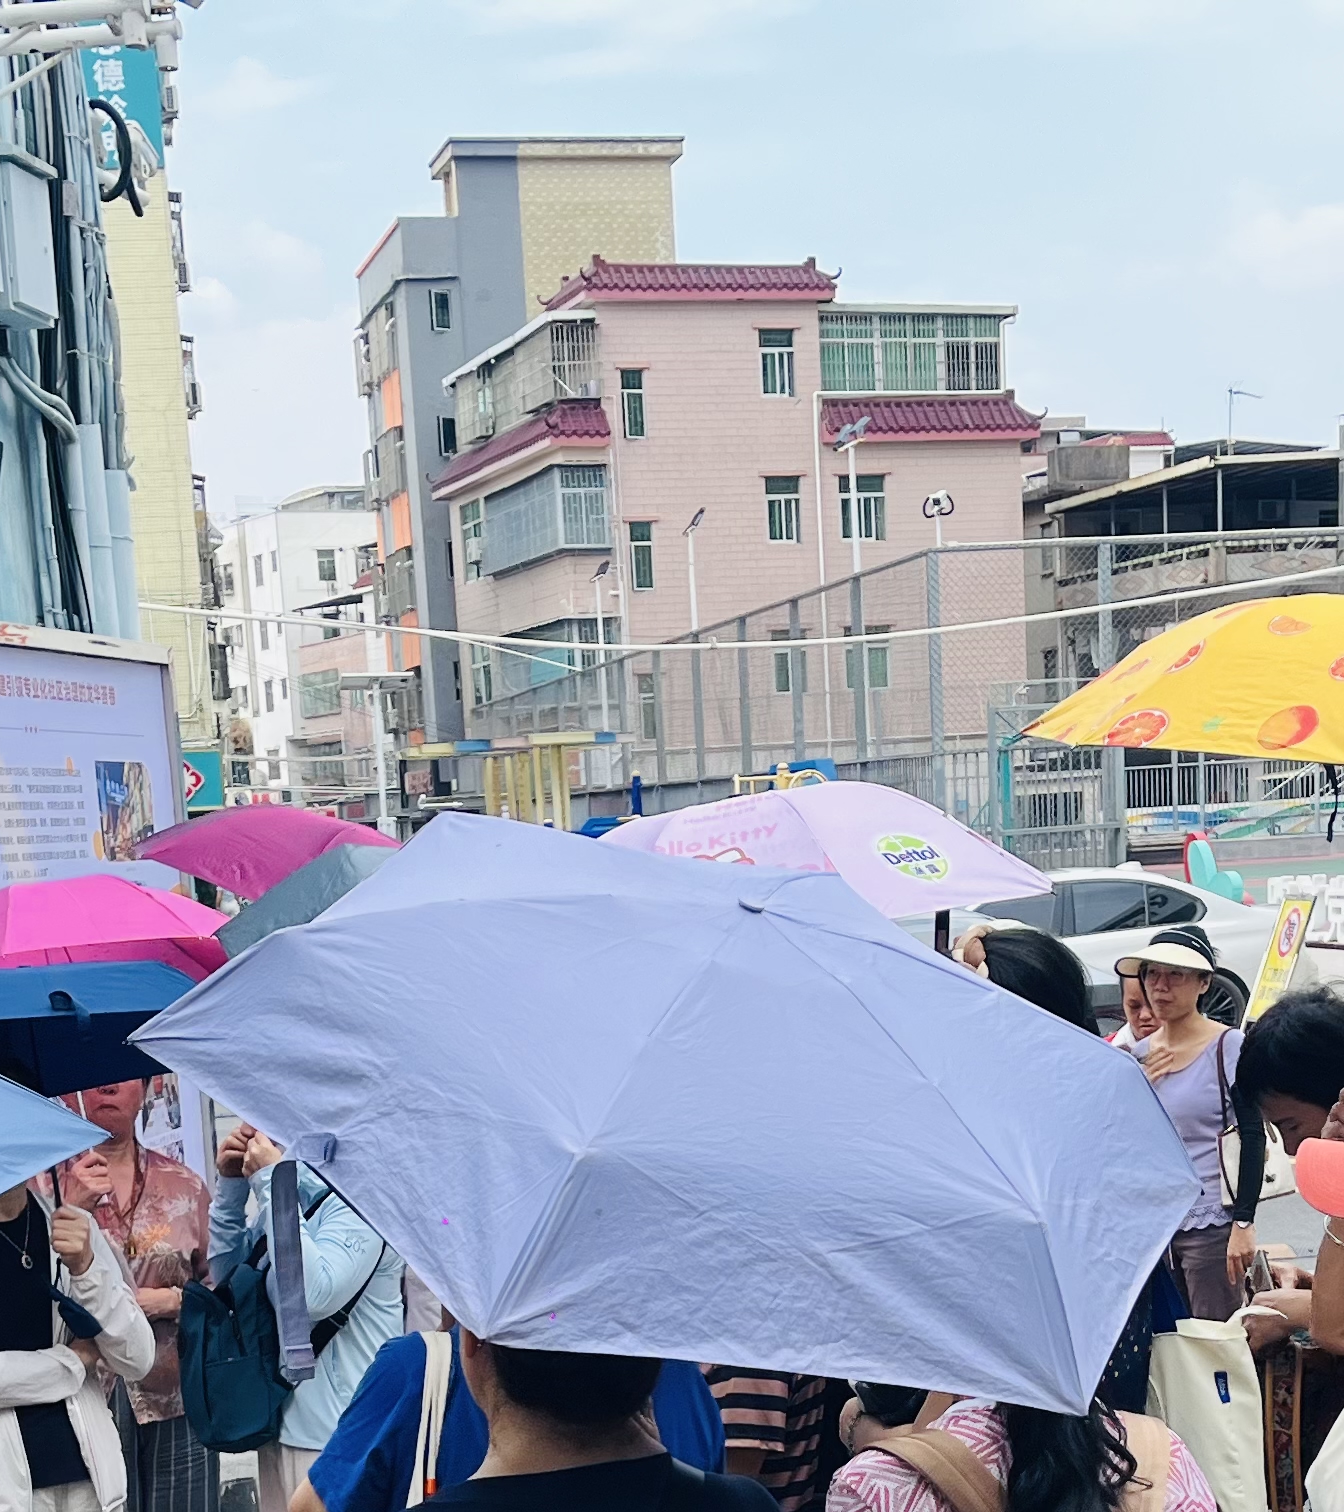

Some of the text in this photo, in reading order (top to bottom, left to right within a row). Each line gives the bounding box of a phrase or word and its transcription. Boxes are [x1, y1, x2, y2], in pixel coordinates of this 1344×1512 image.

[654, 823, 778, 856] ello Kitty
[882, 845, 940, 865] Dettol
